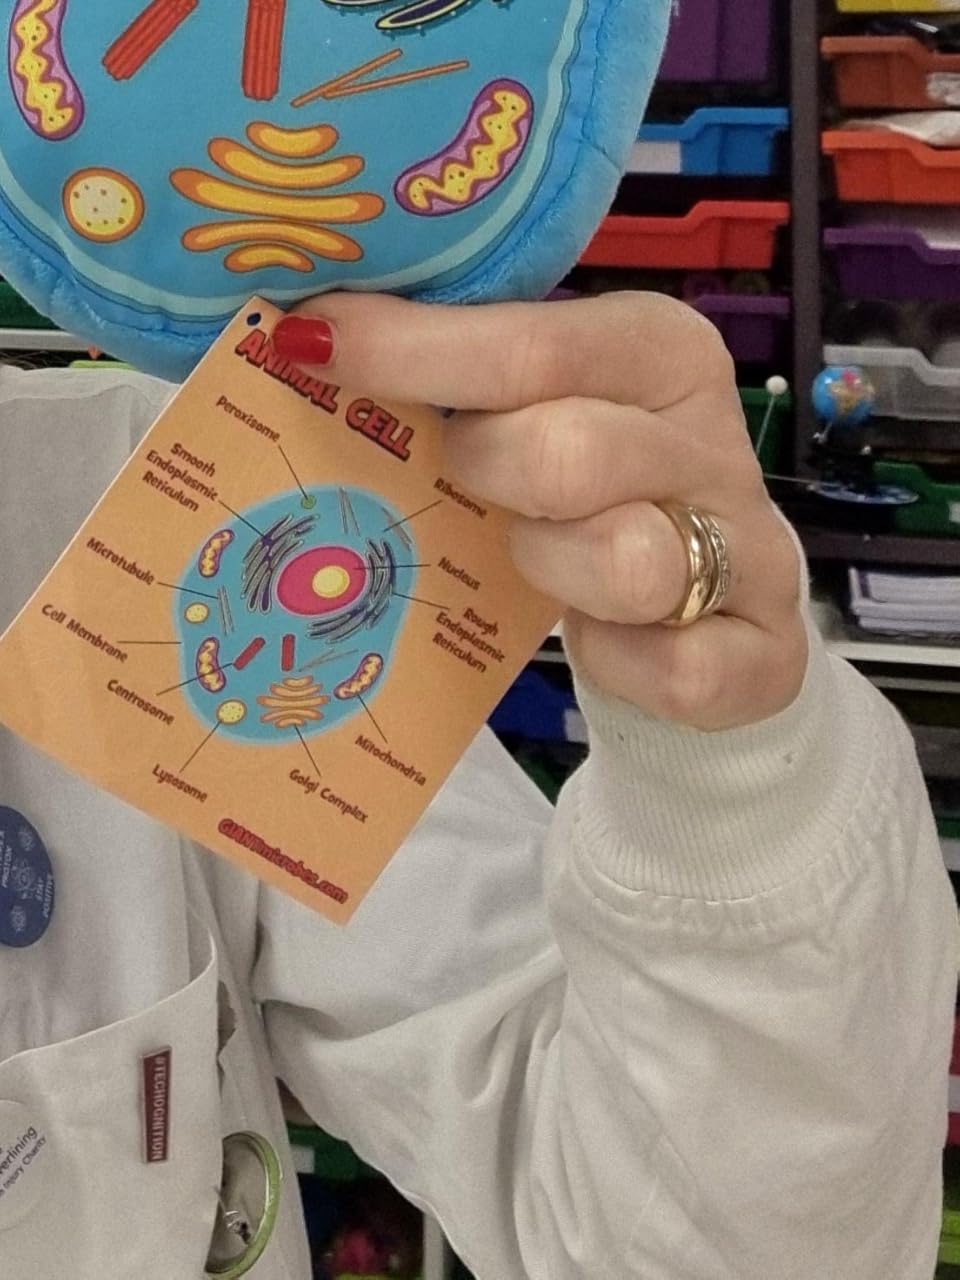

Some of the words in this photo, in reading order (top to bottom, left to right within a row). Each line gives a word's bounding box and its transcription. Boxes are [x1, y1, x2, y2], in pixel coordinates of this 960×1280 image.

[216, 395, 281, 443] Peroxisome
[345, 397, 415, 462] CELL
[146, 449, 219, 502] Endoplasmic
[170, 442, 216, 478] Smooth
[142, 470, 200, 512] Reticulum
[433, 477, 488, 520] Ribosome
[86, 537, 155, 586] Microtubule
[437, 556, 481, 591] Nucleus
[41, 604, 68, 625] Cell
[66, 619, 129, 664] Membrane
[435, 611, 506, 664] Endoplasmic
[463, 607, 499, 638] Rough
[432, 631, 488, 674] Reticulum
[106, 678, 175, 726] Centrosome
[151, 764, 208, 804] Lysosome
[354, 734, 427, 787] Mitochondria
[289, 768, 320, 795] Golgi
[320, 787, 369, 824] Complex
[3, 1165, 25, 1189] Injury
[22, 1136, 47, 1166] Charity
